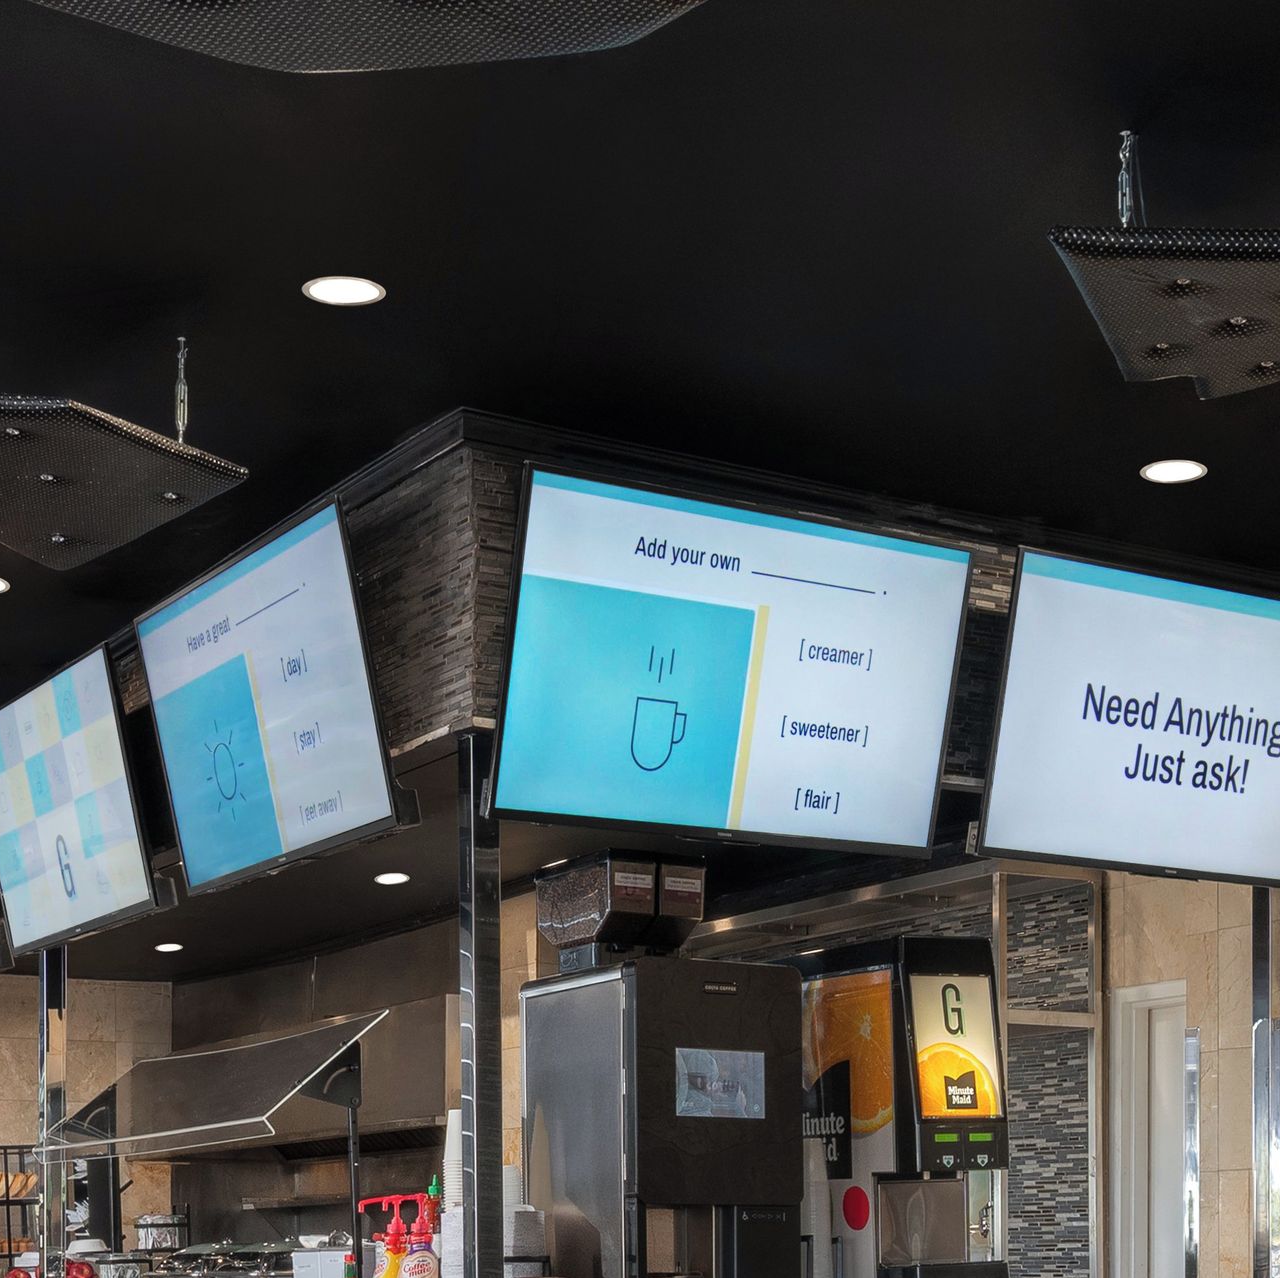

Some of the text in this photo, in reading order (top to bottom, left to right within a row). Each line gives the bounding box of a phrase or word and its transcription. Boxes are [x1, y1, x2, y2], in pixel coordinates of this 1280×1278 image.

[634, 535, 741, 573] Add your own
[187, 614, 231, 653] Have a great
[1082, 682, 1160, 730] Need
[1124, 743, 1250, 794] Just ask!
[941, 983, 965, 1036] G
[947, 1085, 975, 1096] Minute
[952, 1095, 972, 1105] Maid
[403, 1261, 431, 1273] Coffee
[408, 1267, 432, 1278] mate
